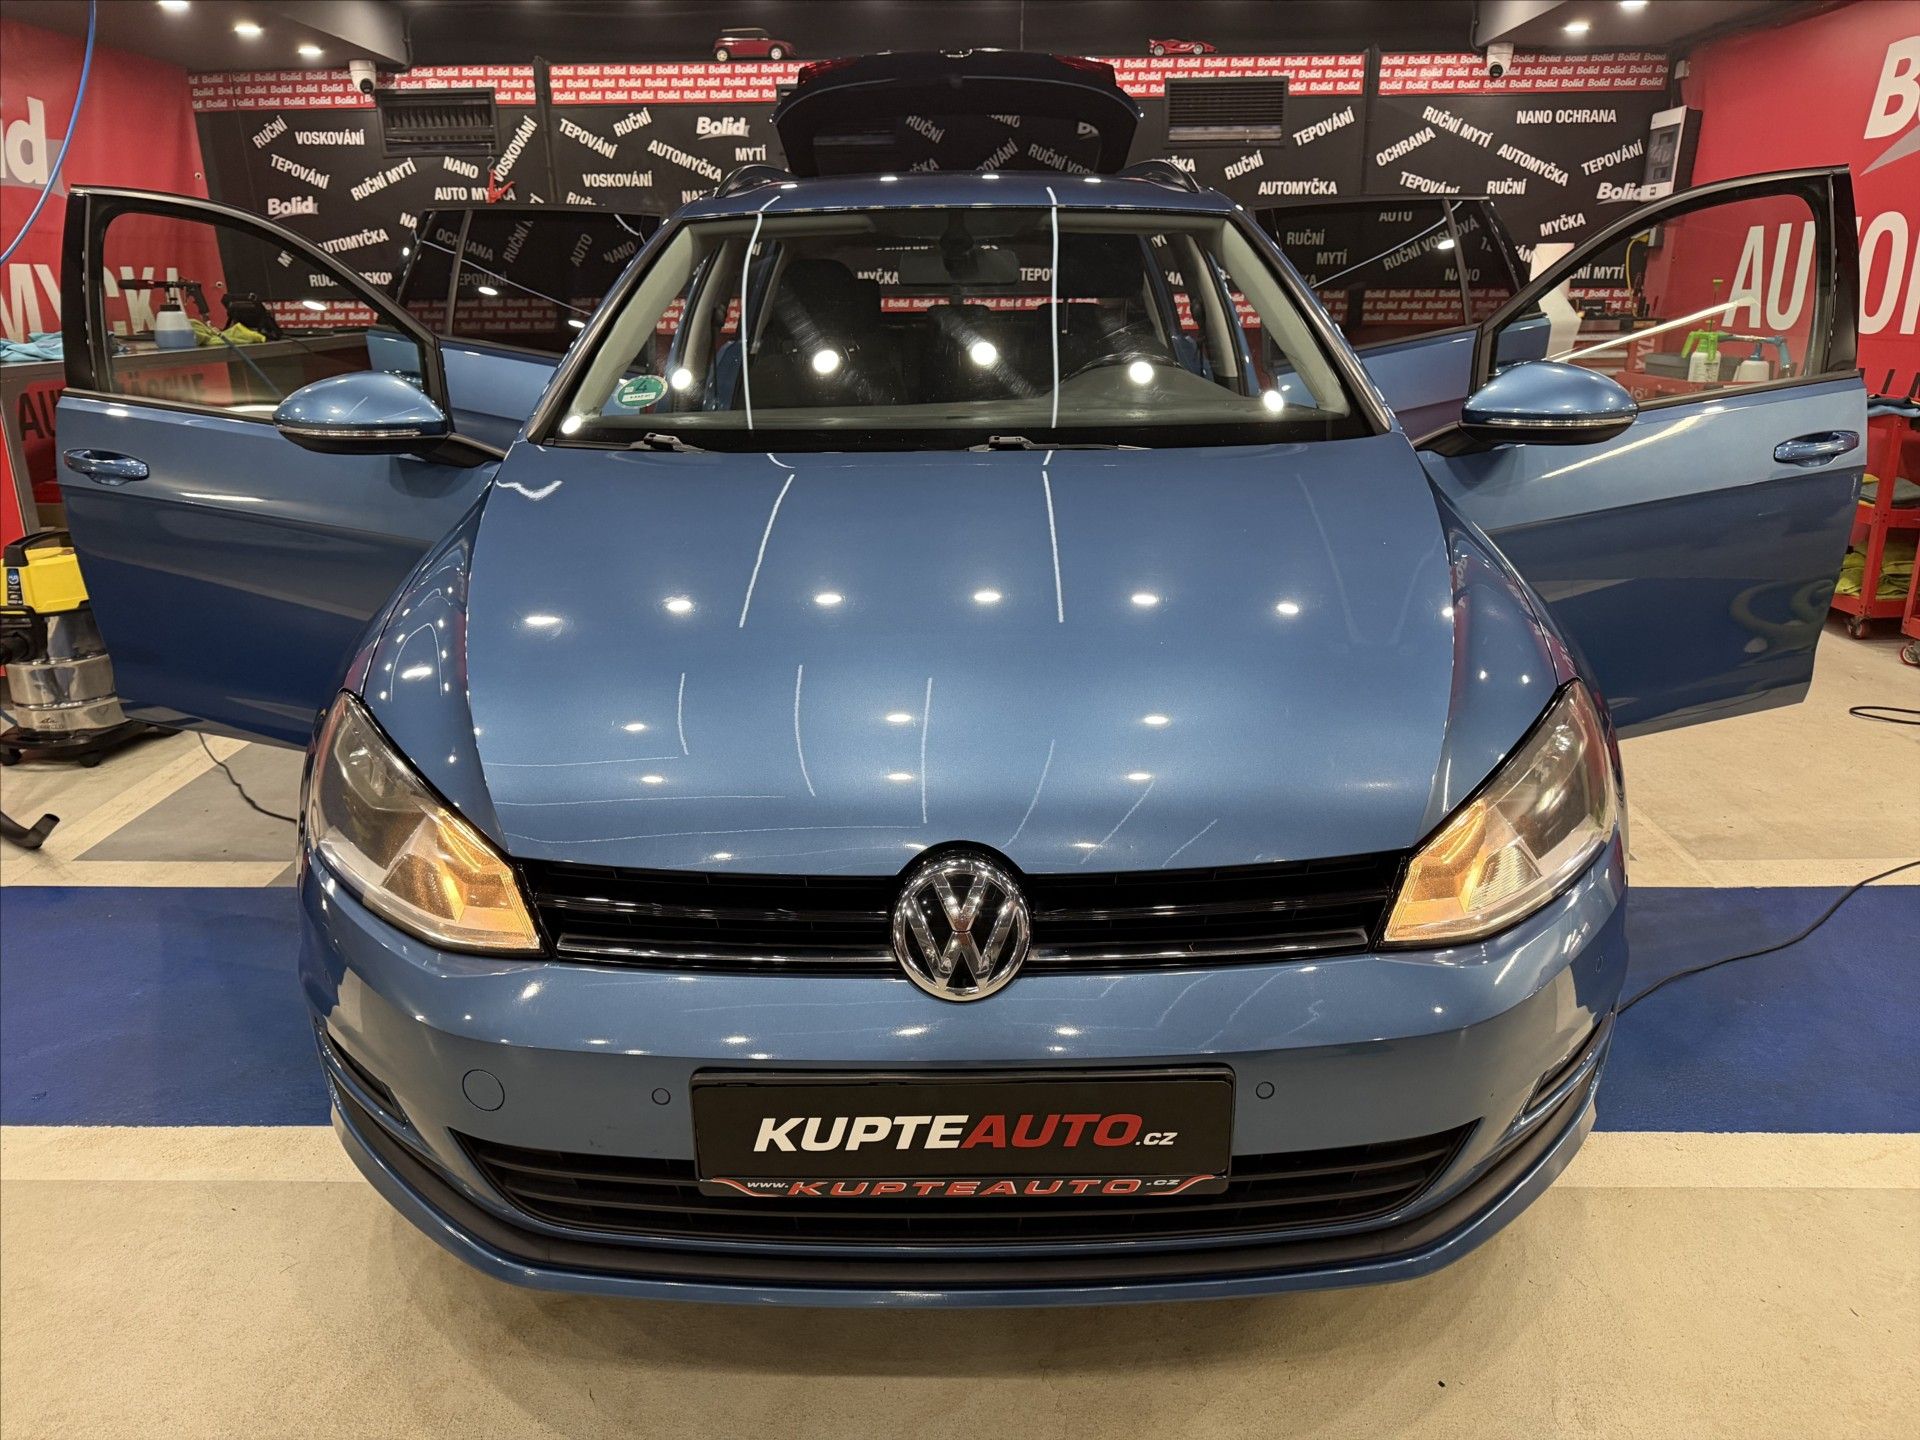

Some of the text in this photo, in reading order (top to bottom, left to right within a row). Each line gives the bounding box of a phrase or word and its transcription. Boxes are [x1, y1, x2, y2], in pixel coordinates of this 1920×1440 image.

[1124, 56, 1361, 68] Bolid Bolid Bolid Bolid Bolid Bolid Bolid Bolid Bolid
[1382, 56, 1404, 65] Bolid
[1408, 56, 1430, 64] Bolid
[1434, 56, 1458, 64] Bolid
[1618, 53, 1640, 61] Bolid
[306, 72, 327, 80] Bolid
[412, 68, 509, 77] Bolid Bolid Bolid Bolid
[552, 67, 573, 75] Bolid
[578, 67, 599, 75] Bolid
[630, 66, 652, 74] Bolid
[656, 66, 678, 74] Bolid
[682, 66, 704, 74] Bolid
[708, 65, 731, 74] Bolid
[735, 65, 757, 73] Bolid
[761, 64, 784, 73] Bolid
[1138, 69, 1349, 80] Bolid Bolid Bolid
[1394, 65, 1652, 77] Bolid Bolid Bolid Bolid Bolid Bolid Bolid Bolid
[401, 79, 523, 89] Bolid Bolid Bolid Bolid
[567, 77, 772, 88] Bolid Bolid Bolid Bolid Bolid Bolid Bolid Bolid
[1123, 82, 1360, 94] Bolid Bolid Bolid
[1380, 81, 1402, 89] Bolid
[1406, 81, 1428, 89] Bolid
[1431, 81, 1454, 89] Bolid
[1457, 80, 1480, 88] Bolid
[1483, 80, 1506, 89] Bolid
[1509, 80, 1532, 88] Bolid
[1535, 79, 1558, 87] Bolid
[1562, 79, 1584, 87] Bolid
[1588, 78, 1610, 86] Bolid
[1614, 78, 1636, 86] Bolid
[554, 89, 759, 100] Bolid Bolid Bolid Bolid Bolid Bolid Bolid Bolid
[612, 107, 653, 137] RUČNÍ
[696, 116, 746, 136] Bolid
[1292, 106, 1355, 146] TEPOVÁNÍ
[1422, 105, 1493, 148] RUČNÍ MYTÍ
[1516, 109, 1617, 125] NANO OCHRANA
[252, 115, 288, 149] RUČNÍ
[295, 129, 365, 145] VOSKOVÁNÍ
[558, 118, 618, 159] TEPOVÁNÍ
[493, 115, 538, 182] VOSKOVÁNÍ
[735, 144, 766, 161] MYTÍ
[1375, 126, 1436, 167] OCHRANA
[647, 140, 722, 182] AUTOMYČKA
[1028, 143, 1067, 174] RUČNÍ
[1224, 150, 1264, 181] RUČNÍ
[1496, 143, 1569, 187] AUTOMYČKA
[1581, 139, 1644, 176] TEPOVÁNÍ
[271, 154, 330, 190] TEPOVÁNÍ
[443, 156, 479, 179] NANO
[350, 157, 417, 201] RUČNÍ MYTÍ
[582, 171, 653, 187] VOSKOVÁNÍ
[1258, 177, 1337, 195] AUTOMYČKA
[1487, 178, 1526, 195] RUČNÍ
[434, 187, 467, 201] AUTO
[267, 196, 314, 216] Bolid
[1540, 212, 1586, 237] MYČKA
[317, 228, 389, 254] UTOMYČKA
[1286, 229, 1325, 246] RUČNÍ
[570, 233, 592, 267] AUTO
[1316, 249, 1347, 265] MYTÍ
[1382, 244, 1420, 271] RUČNÍ
[1593, 264, 1625, 279] MYTÍ
[752, 1113, 1178, 1153] KUPTEAUTO.cz
